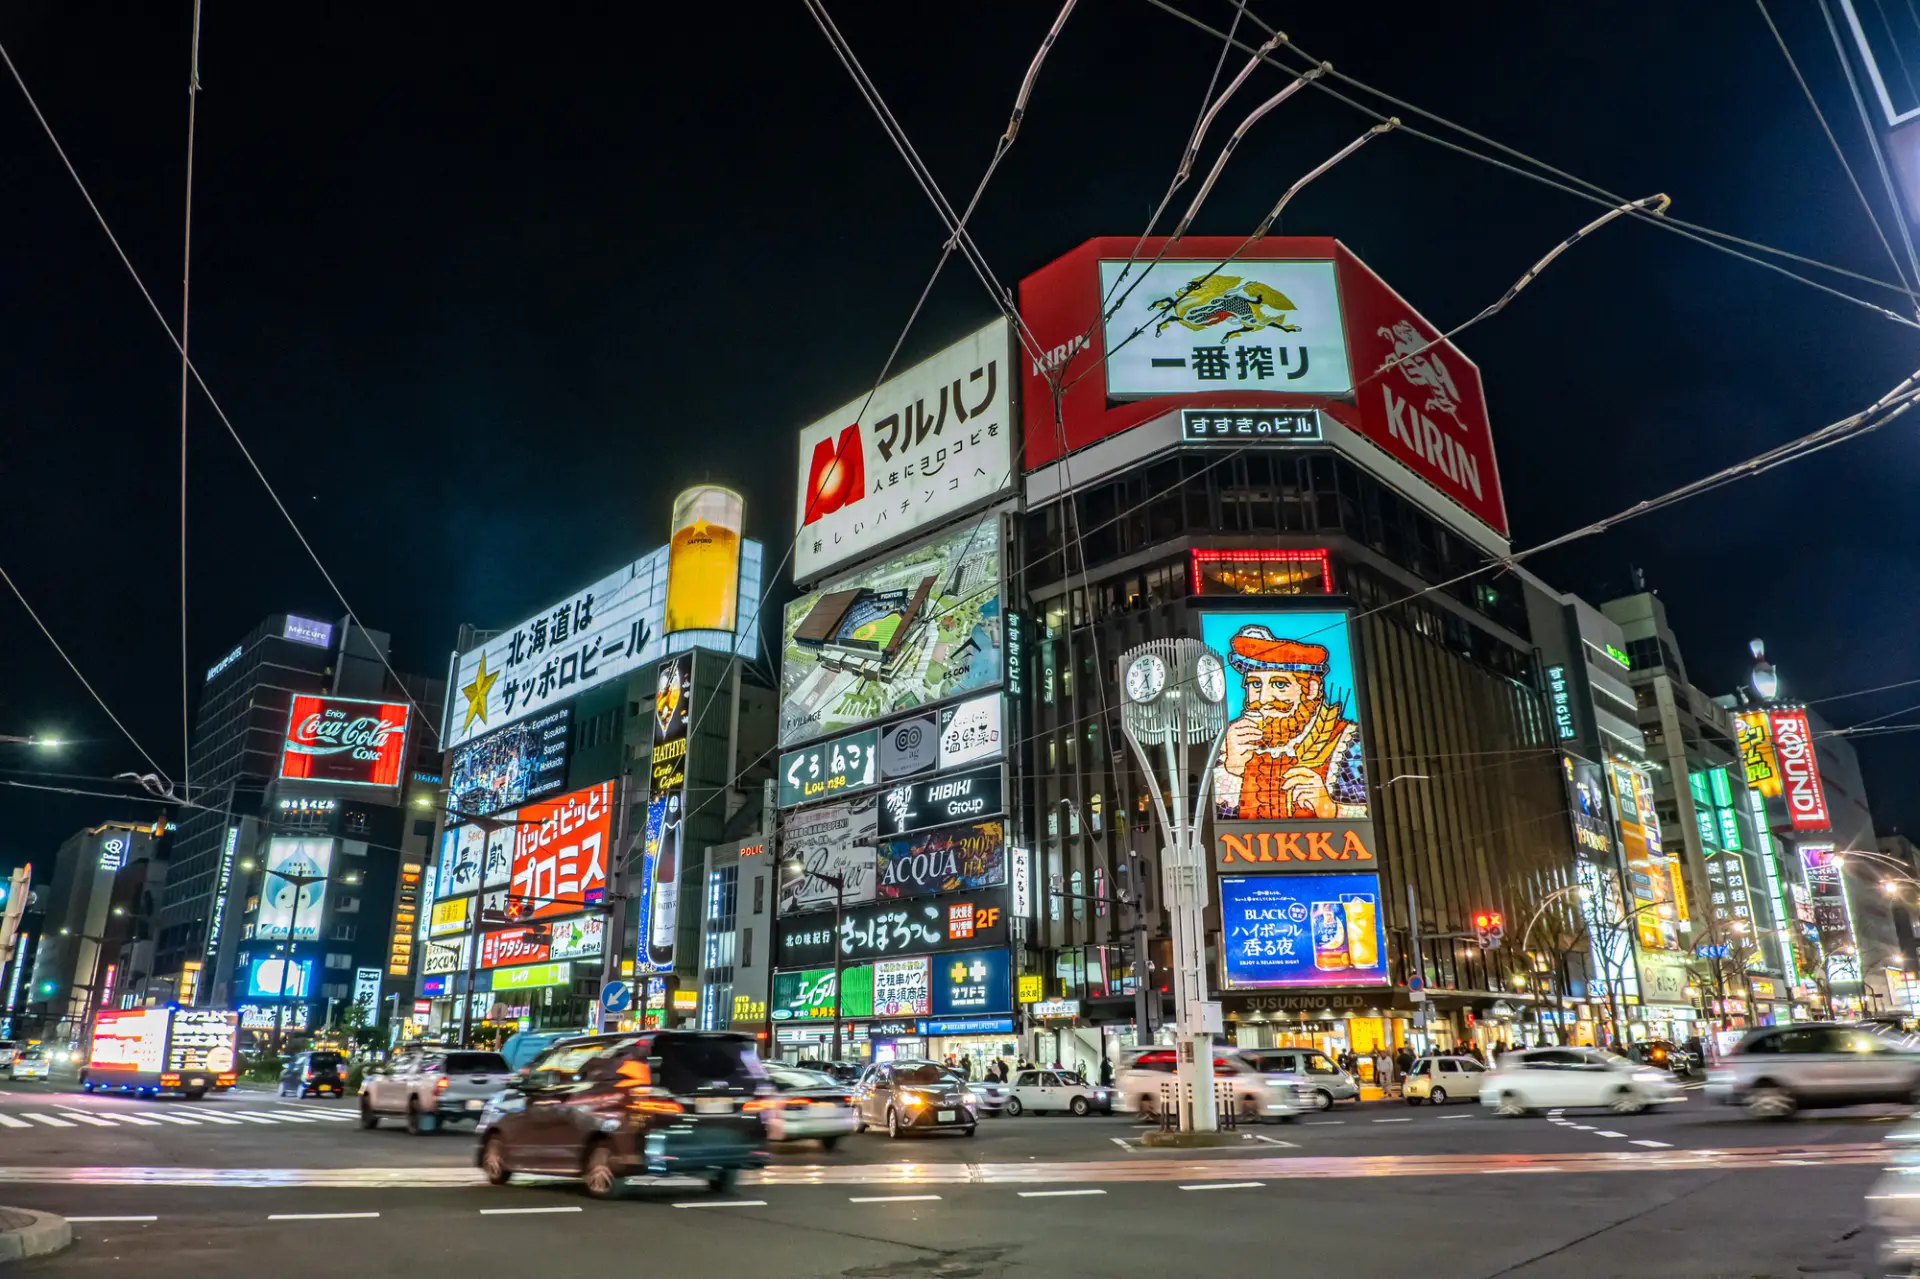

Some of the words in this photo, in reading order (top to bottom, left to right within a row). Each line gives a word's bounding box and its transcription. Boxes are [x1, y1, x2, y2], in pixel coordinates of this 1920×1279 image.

[1031, 333, 1091, 377] KIRIN
[1151, 345, 1311, 381] 一番搾り
[874, 359, 997, 463] マルハン
[1190, 416, 1313, 435] すすきのビル
[1381, 383, 1484, 502] KIRIN
[873, 422, 999, 495] 人生にヨロコビを
[812, 467, 986, 555] 新しいパチンコへ
[288, 625, 327, 640] Mercure
[506, 593, 595, 668] 北海道は
[502, 618, 651, 716] サッポロビール
[325, 709, 347, 720] Enjoy
[352, 747, 383, 761] Coke
[543, 741, 565, 755] Sapporo
[652, 737, 687, 764] HATHYR
[787, 744, 861, 789] くろねこ
[804, 773, 846, 796] Lounge
[928, 779, 972, 802] HIBIKI
[947, 798, 984, 815] Group
[740, 844, 764, 857] POLIC
[1219, 830, 1374, 864] NIKKA
[513, 831, 605, 912] プロミス
[881, 849, 958, 886] ACQUA
[976, 907, 999, 929] 2F
[1245, 909, 1288, 920] BLACK
[271, 926, 316, 936] DAKIN
[785, 931, 830, 947] 北の味紀行
[836, 906, 941, 954] さっぽろっこ
[1231, 923, 1303, 938] ハイボール
[1242, 936, 1296, 957] 香る夜
[877, 972, 922, 988] 元祖串かつ
[877, 986, 927, 1002] 恵美須商店
[951, 985, 986, 999] サツドラ
[1246, 995, 1326, 1010] SUSUKINO
[1333, 995, 1368, 1009] BLD.
